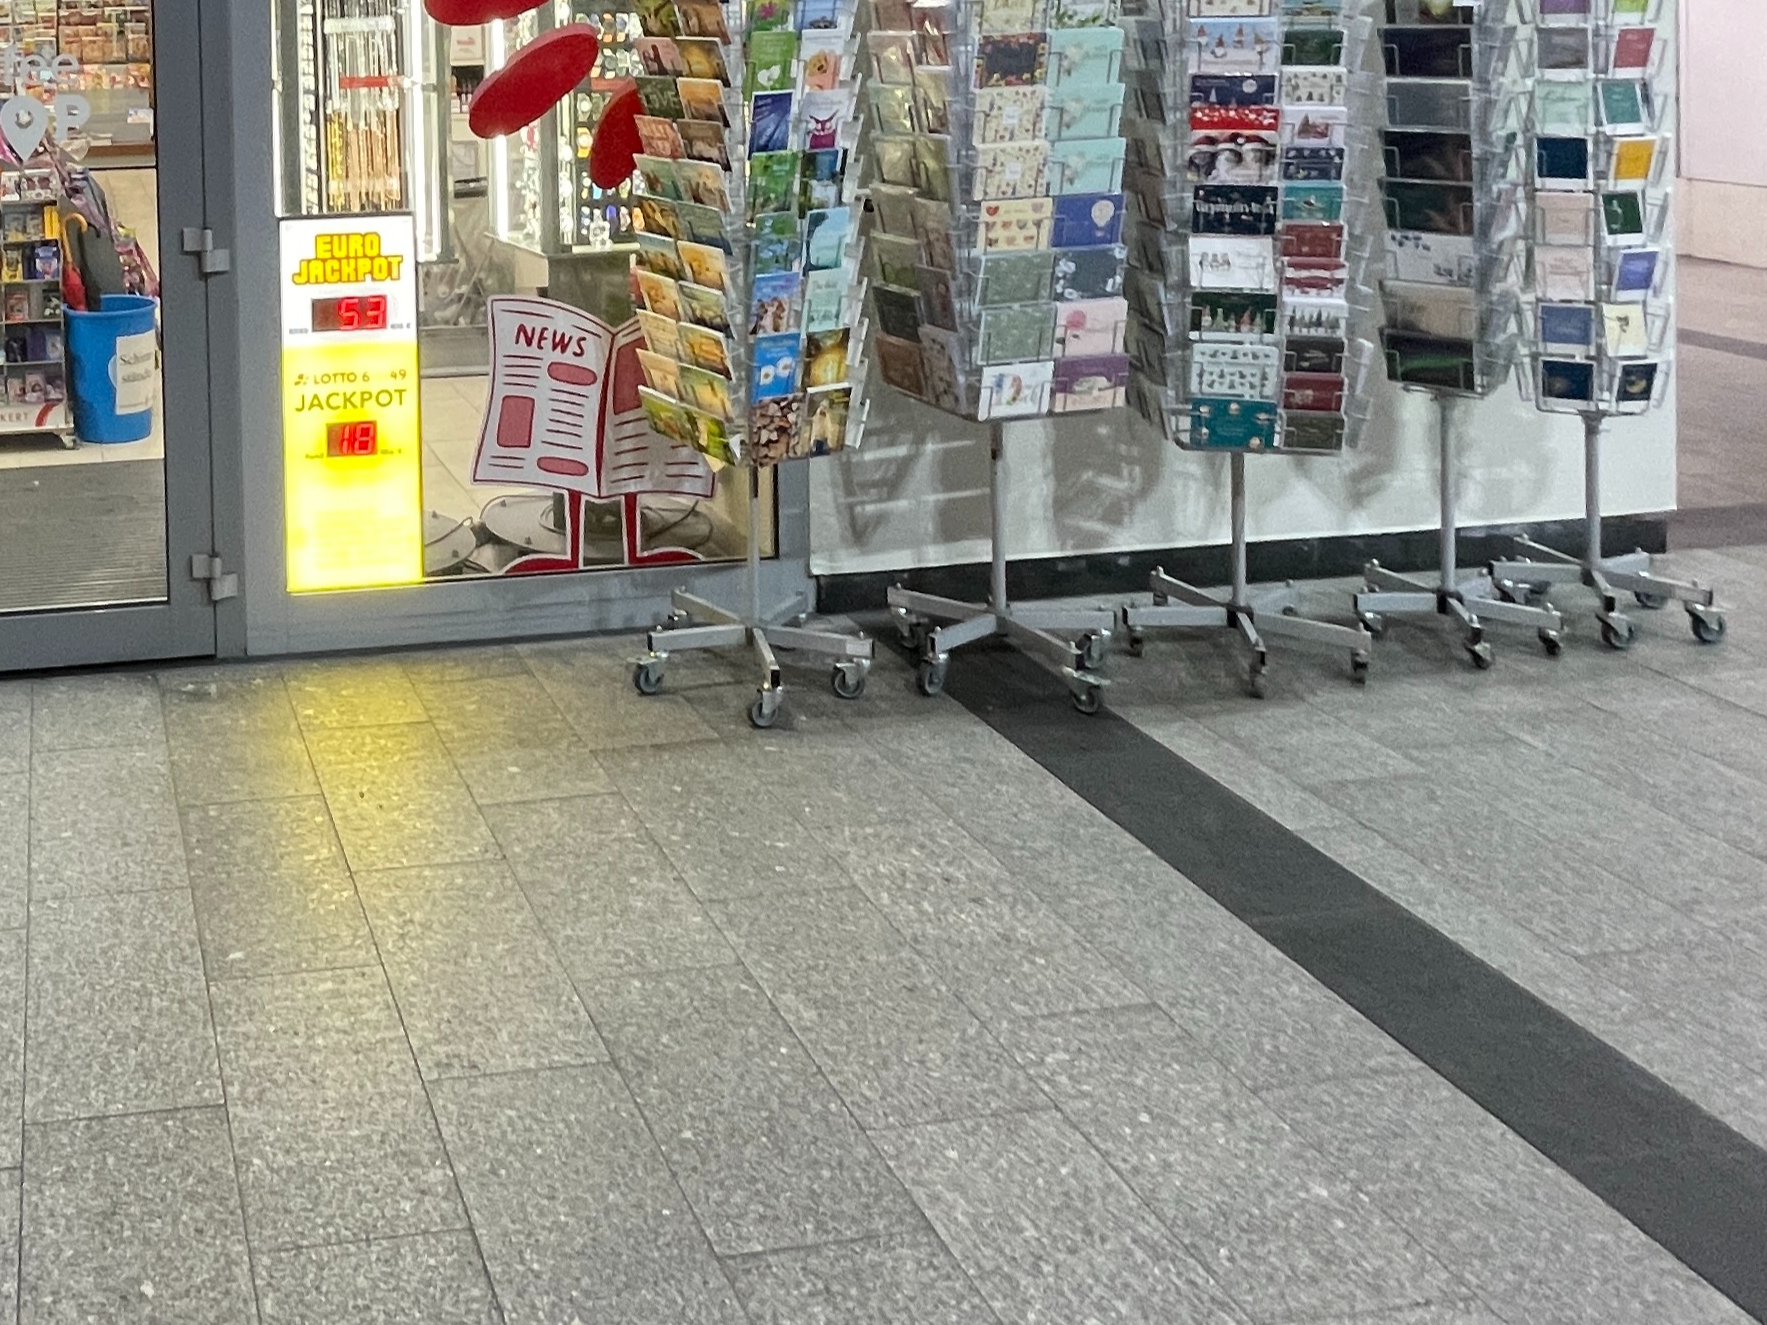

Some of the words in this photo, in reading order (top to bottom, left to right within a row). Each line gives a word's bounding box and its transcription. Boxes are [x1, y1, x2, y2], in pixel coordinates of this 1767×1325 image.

[314, 231, 382, 259] EURO
[291, 255, 404, 286] JACKPOT
[339, 296, 386, 331] 53
[514, 323, 588, 357] NEWS
[313, 372, 358, 385] LOTTO
[361, 371, 371, 382] 6
[389, 368, 407, 381] 49
[294, 389, 407, 412] JACKPOT
[341, 423, 375, 455] 18
